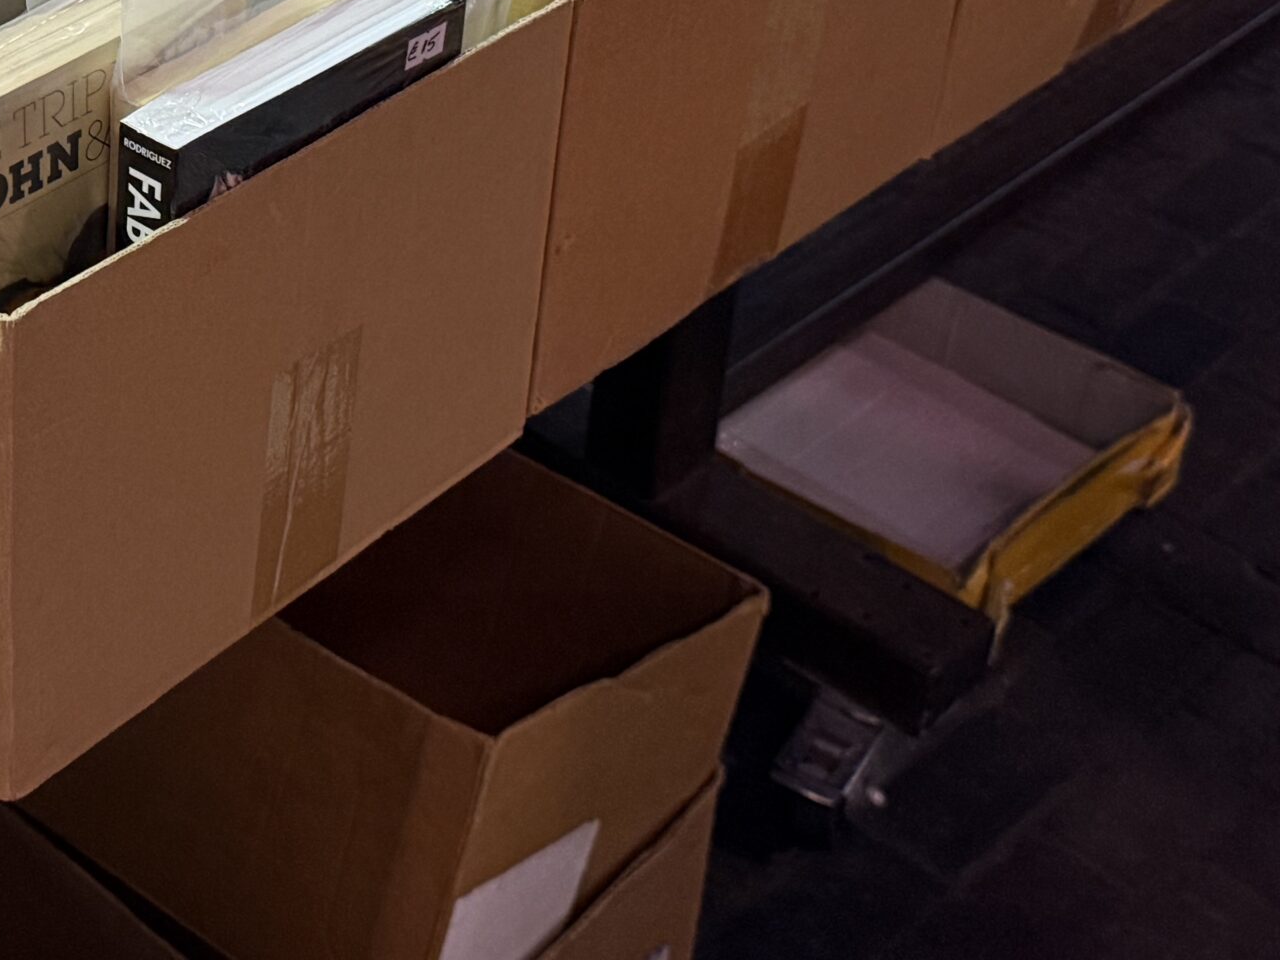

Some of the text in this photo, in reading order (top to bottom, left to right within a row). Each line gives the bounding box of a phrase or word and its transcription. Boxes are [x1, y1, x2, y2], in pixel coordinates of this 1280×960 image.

[12, 67, 108, 150] TRIP
[84, 119, 111, 162] &
[122, 136, 173, 171] RODRIGUEZ
